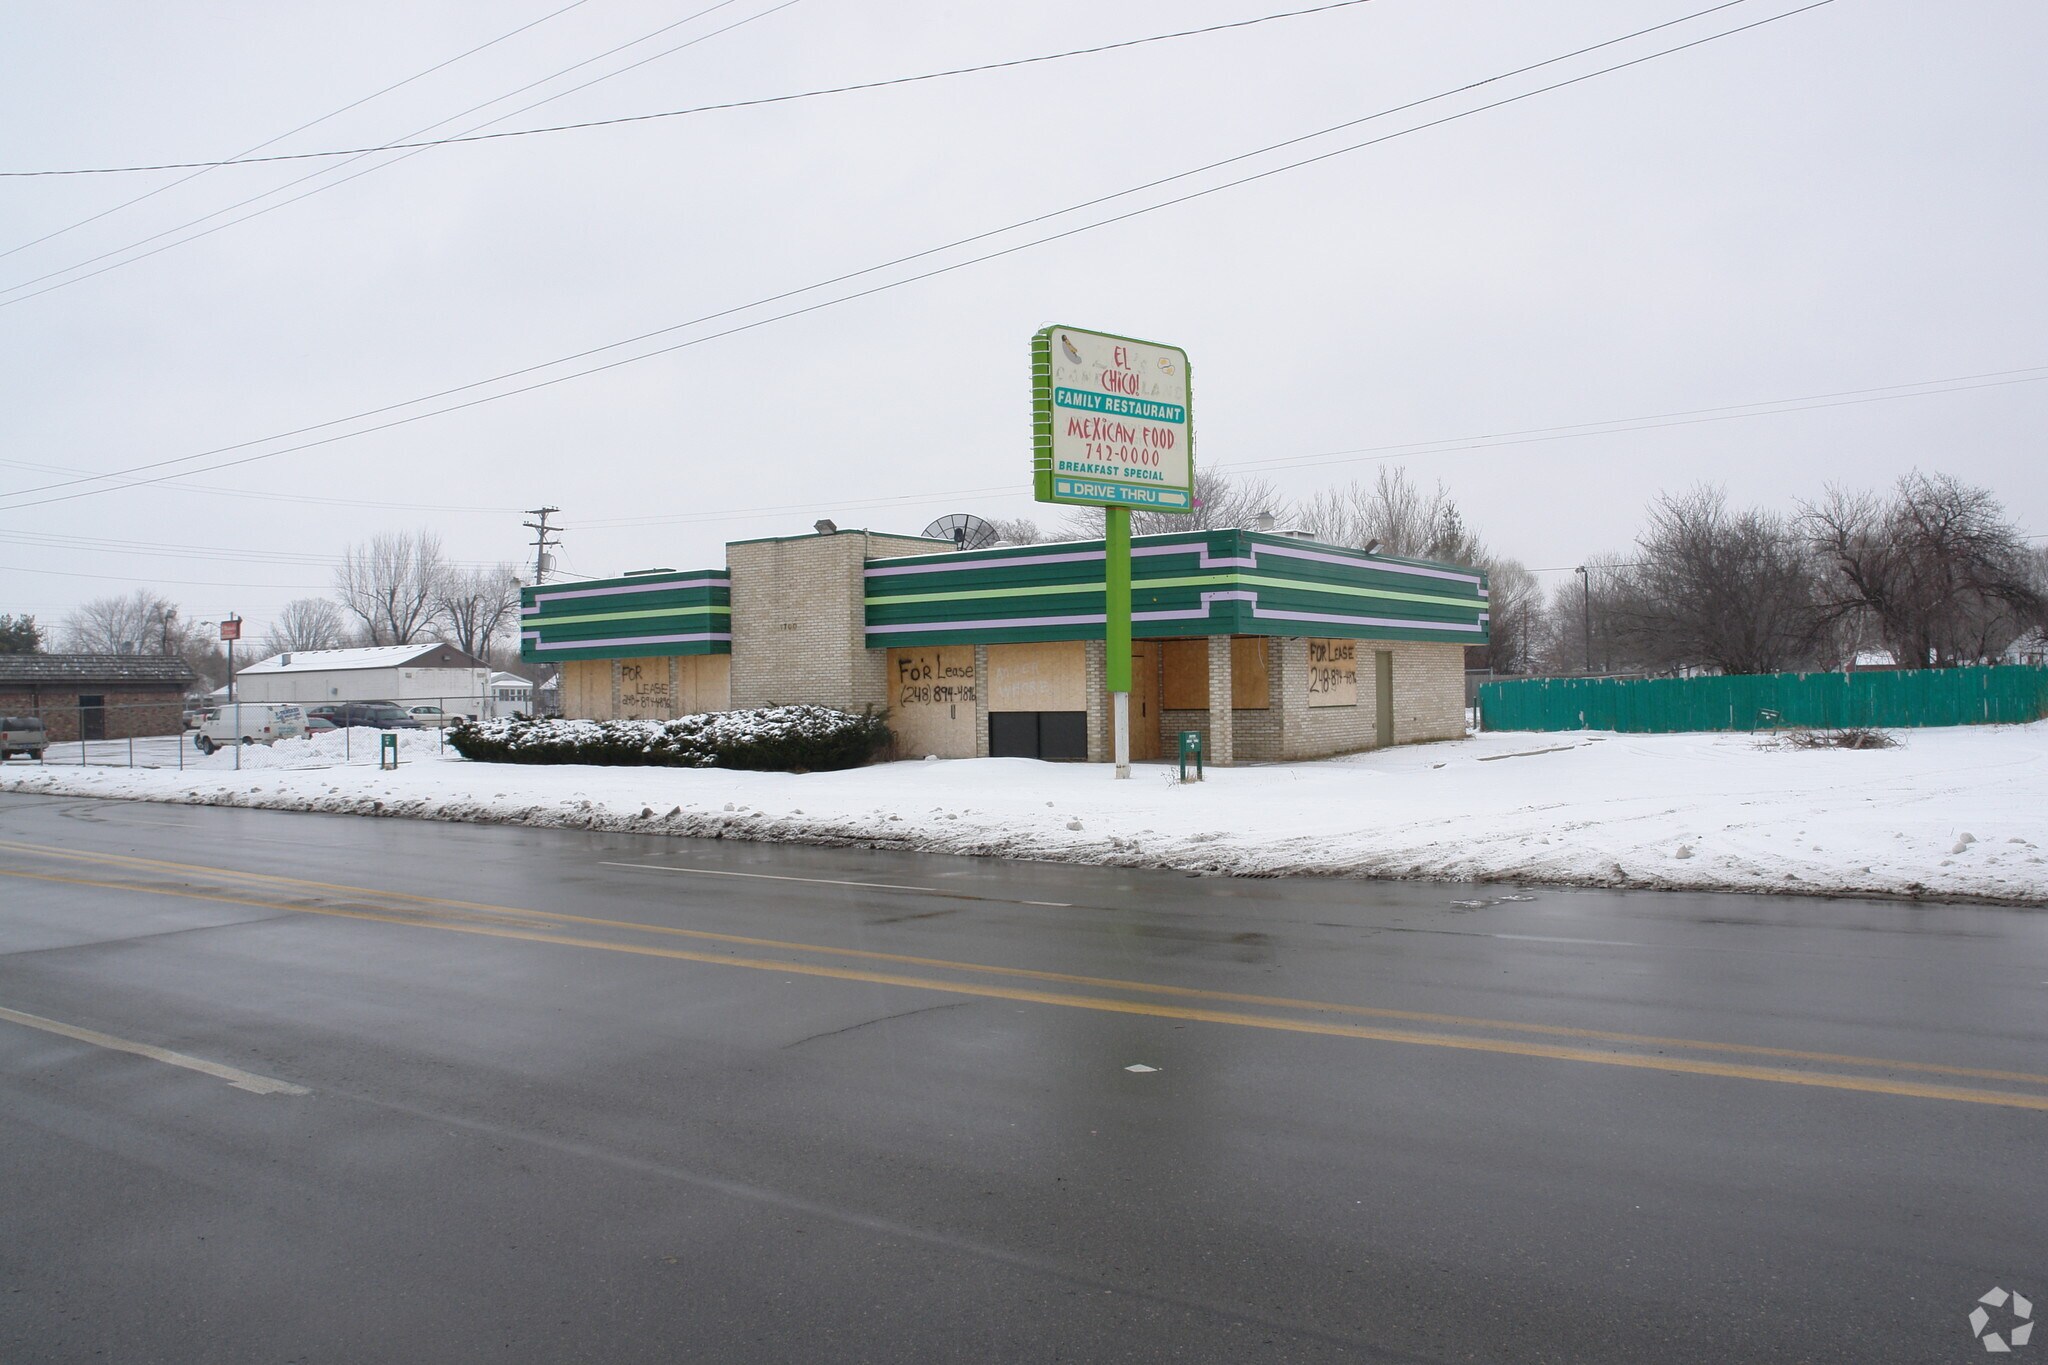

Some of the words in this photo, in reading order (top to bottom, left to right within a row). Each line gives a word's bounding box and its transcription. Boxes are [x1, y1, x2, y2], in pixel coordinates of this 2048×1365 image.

[1114, 346, 1131, 370] EL
[1057, 390, 1102, 409] FAMILY
[1105, 398, 1181, 421] RESTAURANT
[1143, 426, 1175, 450] FOOD
[1086, 443, 1160, 468] 742-0000
[1058, 460, 1120, 476] BREAKFAST
[1123, 469, 1164, 481] SPECIAL
[1073, 483, 1116, 499] DRIVE
[1120, 487, 1156, 502] THRU
[1310, 642, 1327, 662] FOR
[622, 665, 643, 682] FOR
[937, 654, 974, 679] Lease
[636, 683, 669, 695] LEASE
